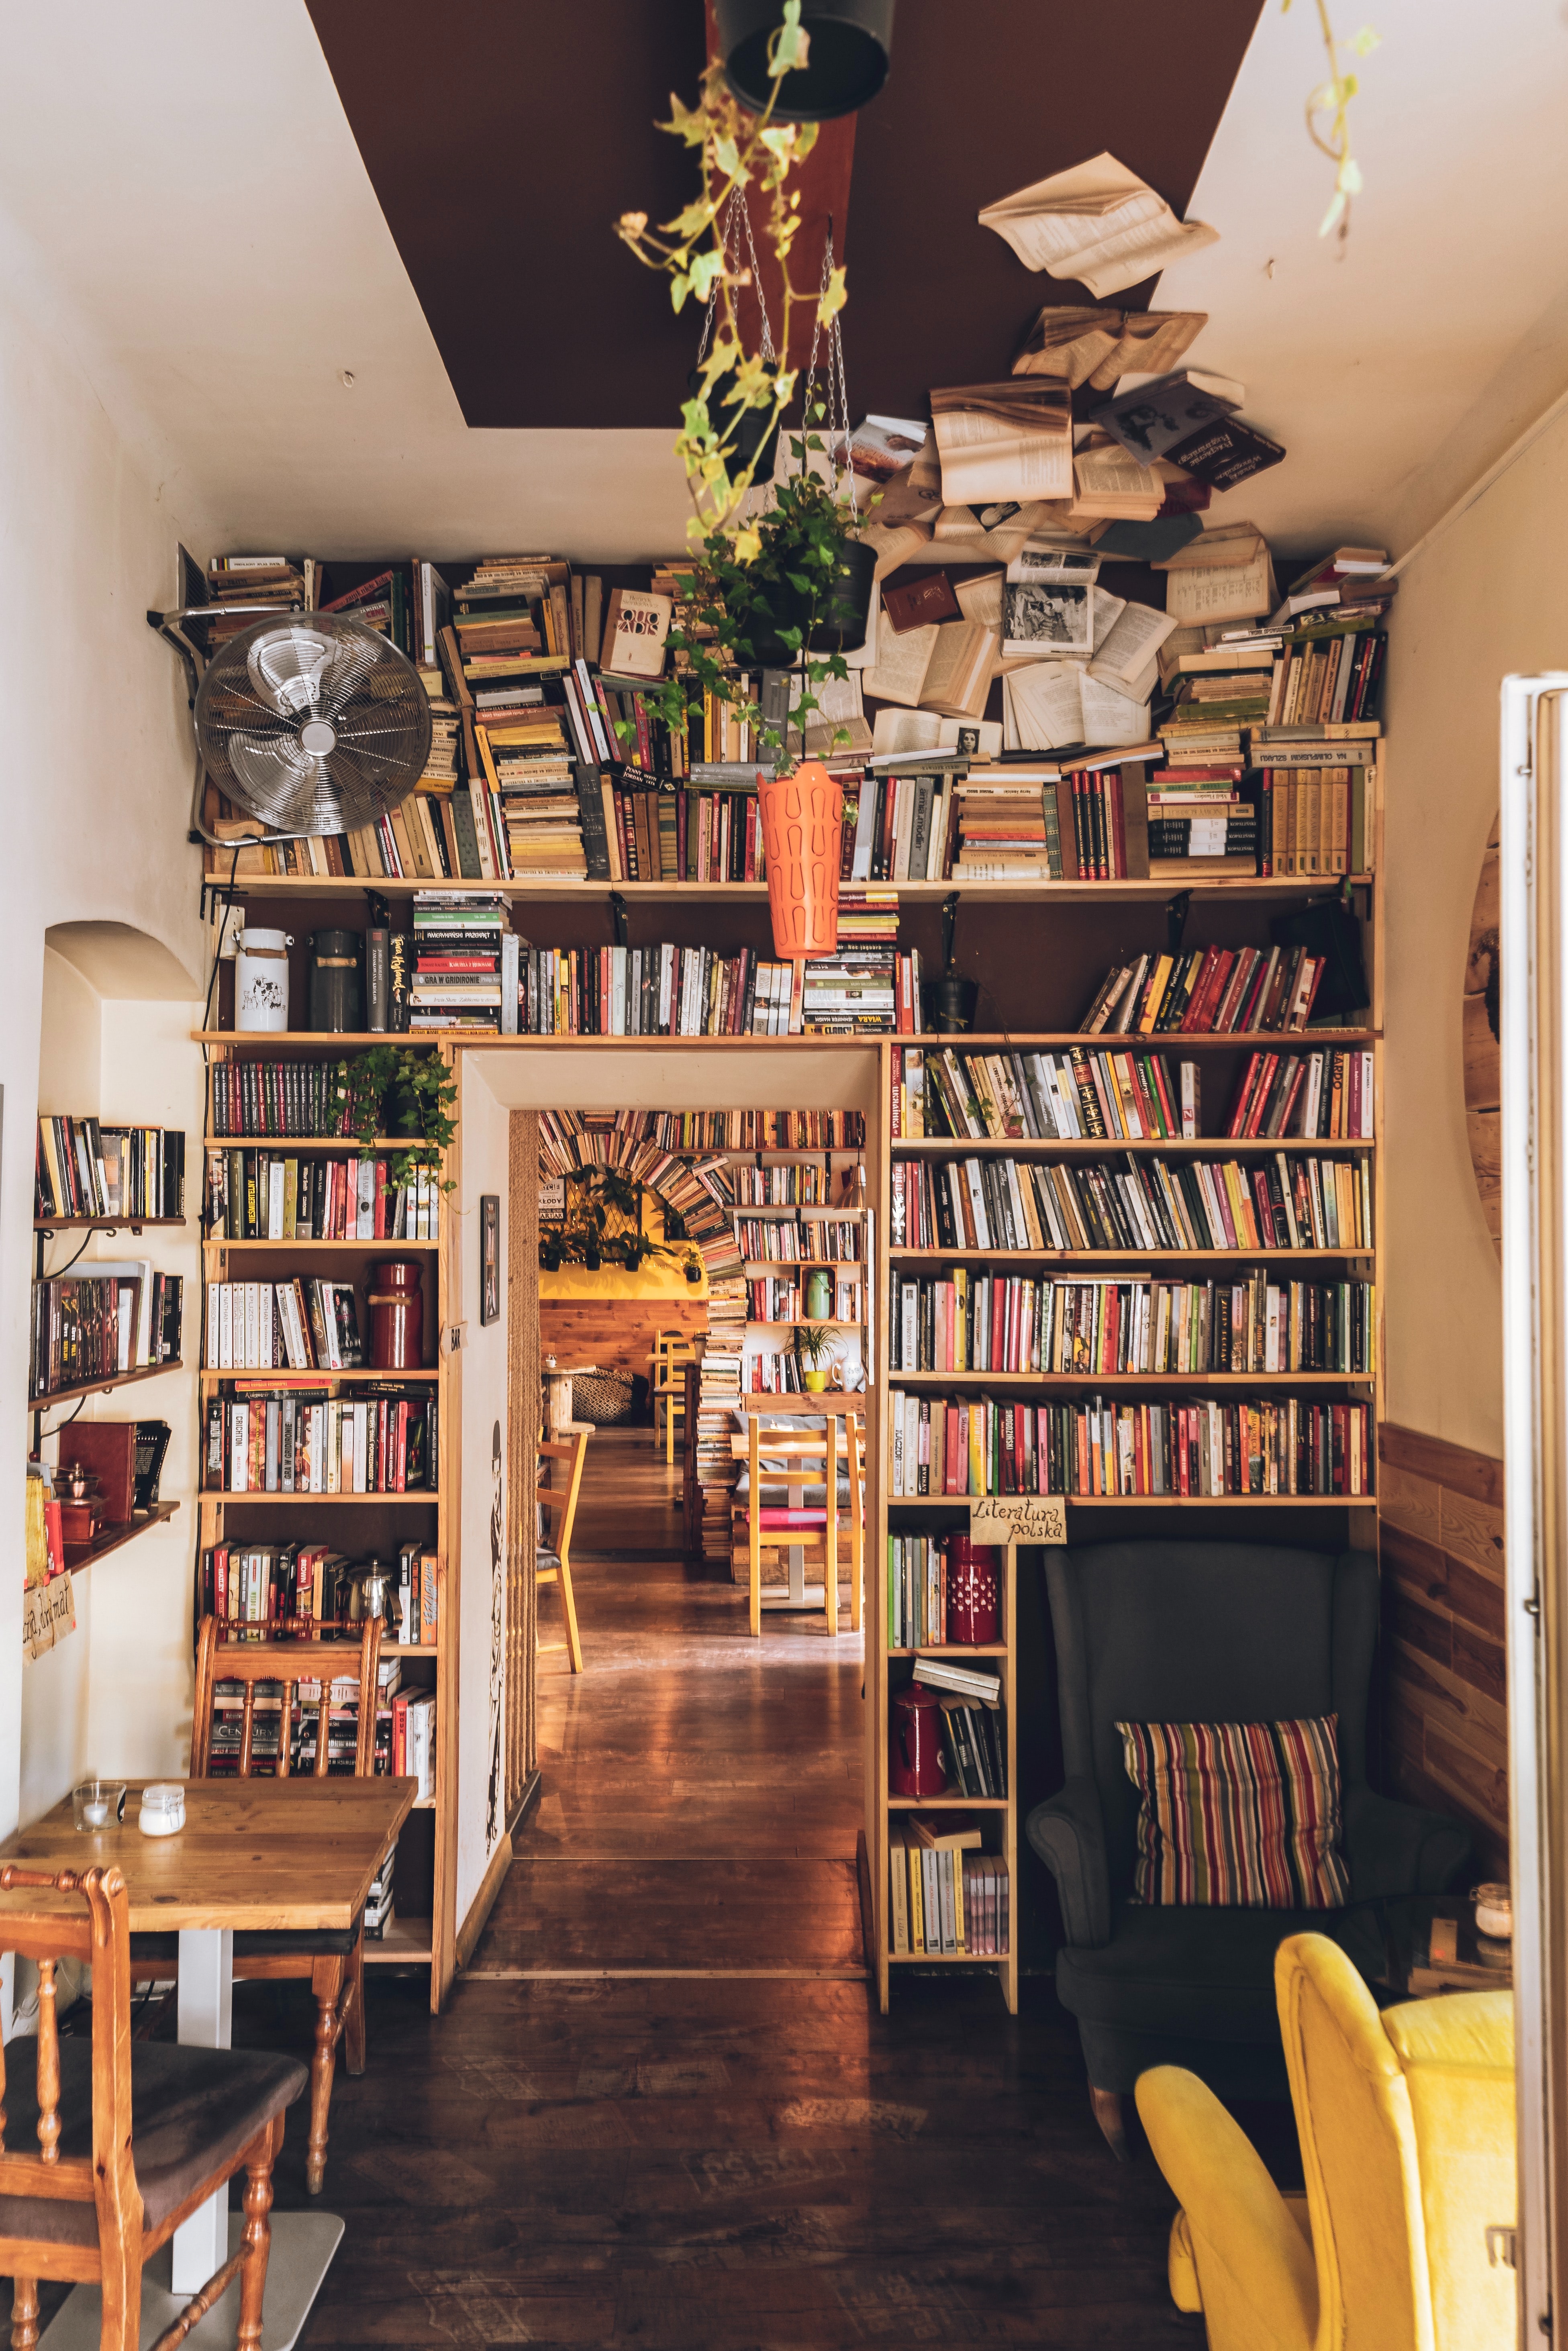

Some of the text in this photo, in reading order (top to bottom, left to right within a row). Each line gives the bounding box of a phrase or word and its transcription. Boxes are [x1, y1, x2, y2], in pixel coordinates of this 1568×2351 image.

[366, 608, 386, 618] CENĘ
[621, 610, 660, 624] QUO
[623, 771, 643, 782] JORDAN
[625, 766, 641, 776] PENNY
[917, 788, 927, 814] armia
[379, 828, 387, 852] KULINARNE
[383, 827, 391, 852] KULINARNE
[391, 937, 406, 991] Tara Hyland
[1333, 1051, 1343, 1090] BARDO
[247, 1180, 255, 1223] NIEŚMIERTELNY
[1273, 1186, 1281, 1203] KOZAK
[451, 1328, 461, 1351] BAR
[210, 1421, 220, 1437] GWIAZDA
[284, 1423, 292, 1458] GRIDIRONIE
[1005, 1414, 1014, 1450] ROGOZIŃSKI
[284, 1467, 292, 1479] GRA
[972, 1498, 1060, 1522] Literatura
[1007, 1520, 1063, 1543] polska
[39, 1579, 69, 1629] dramat
[424, 1563, 434, 1626] HIPNOTYZER
